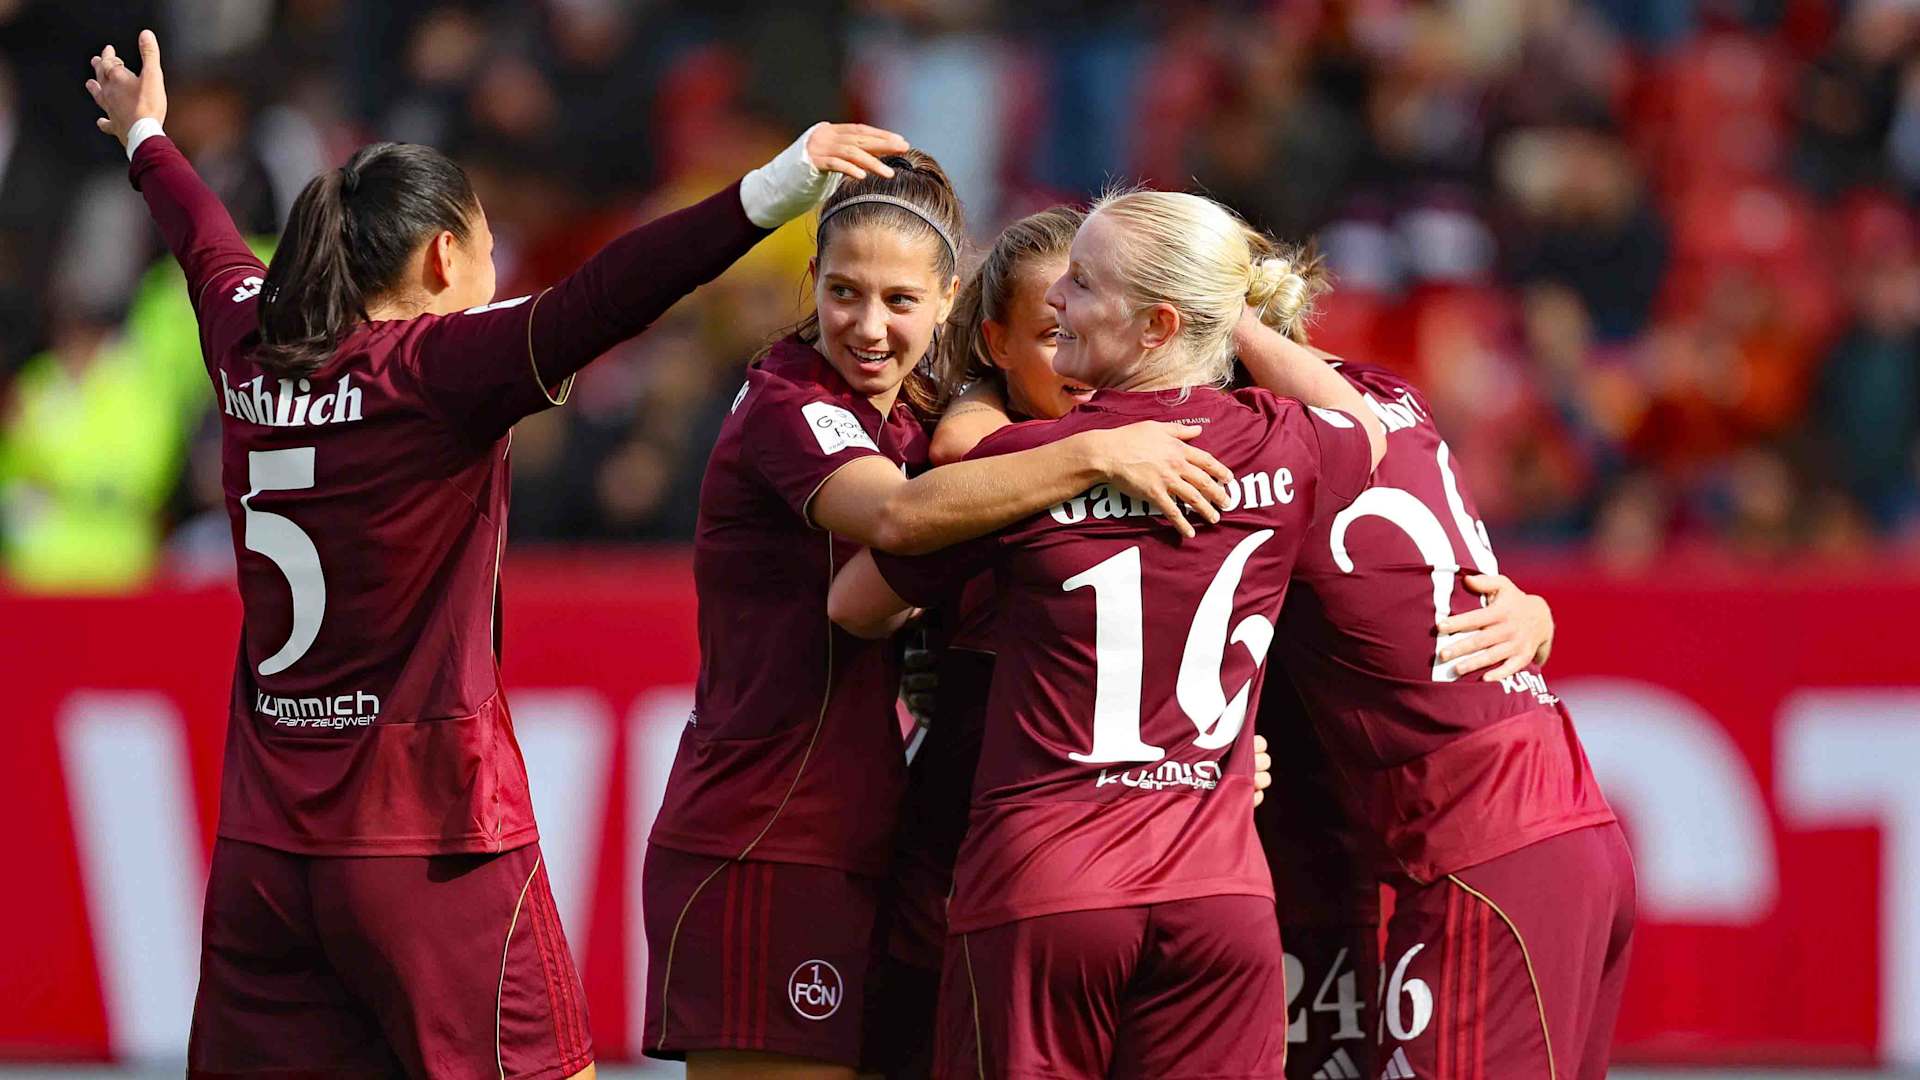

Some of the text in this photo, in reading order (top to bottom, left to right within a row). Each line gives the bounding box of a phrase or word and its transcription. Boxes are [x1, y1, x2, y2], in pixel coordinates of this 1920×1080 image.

[240, 446, 326, 676] 5
[1062, 528, 1275, 763] 16
[274, 713, 377, 730] Fahrzeugwelt
[811, 964, 823, 985] 1.
[794, 982, 836, 1007] FCN
